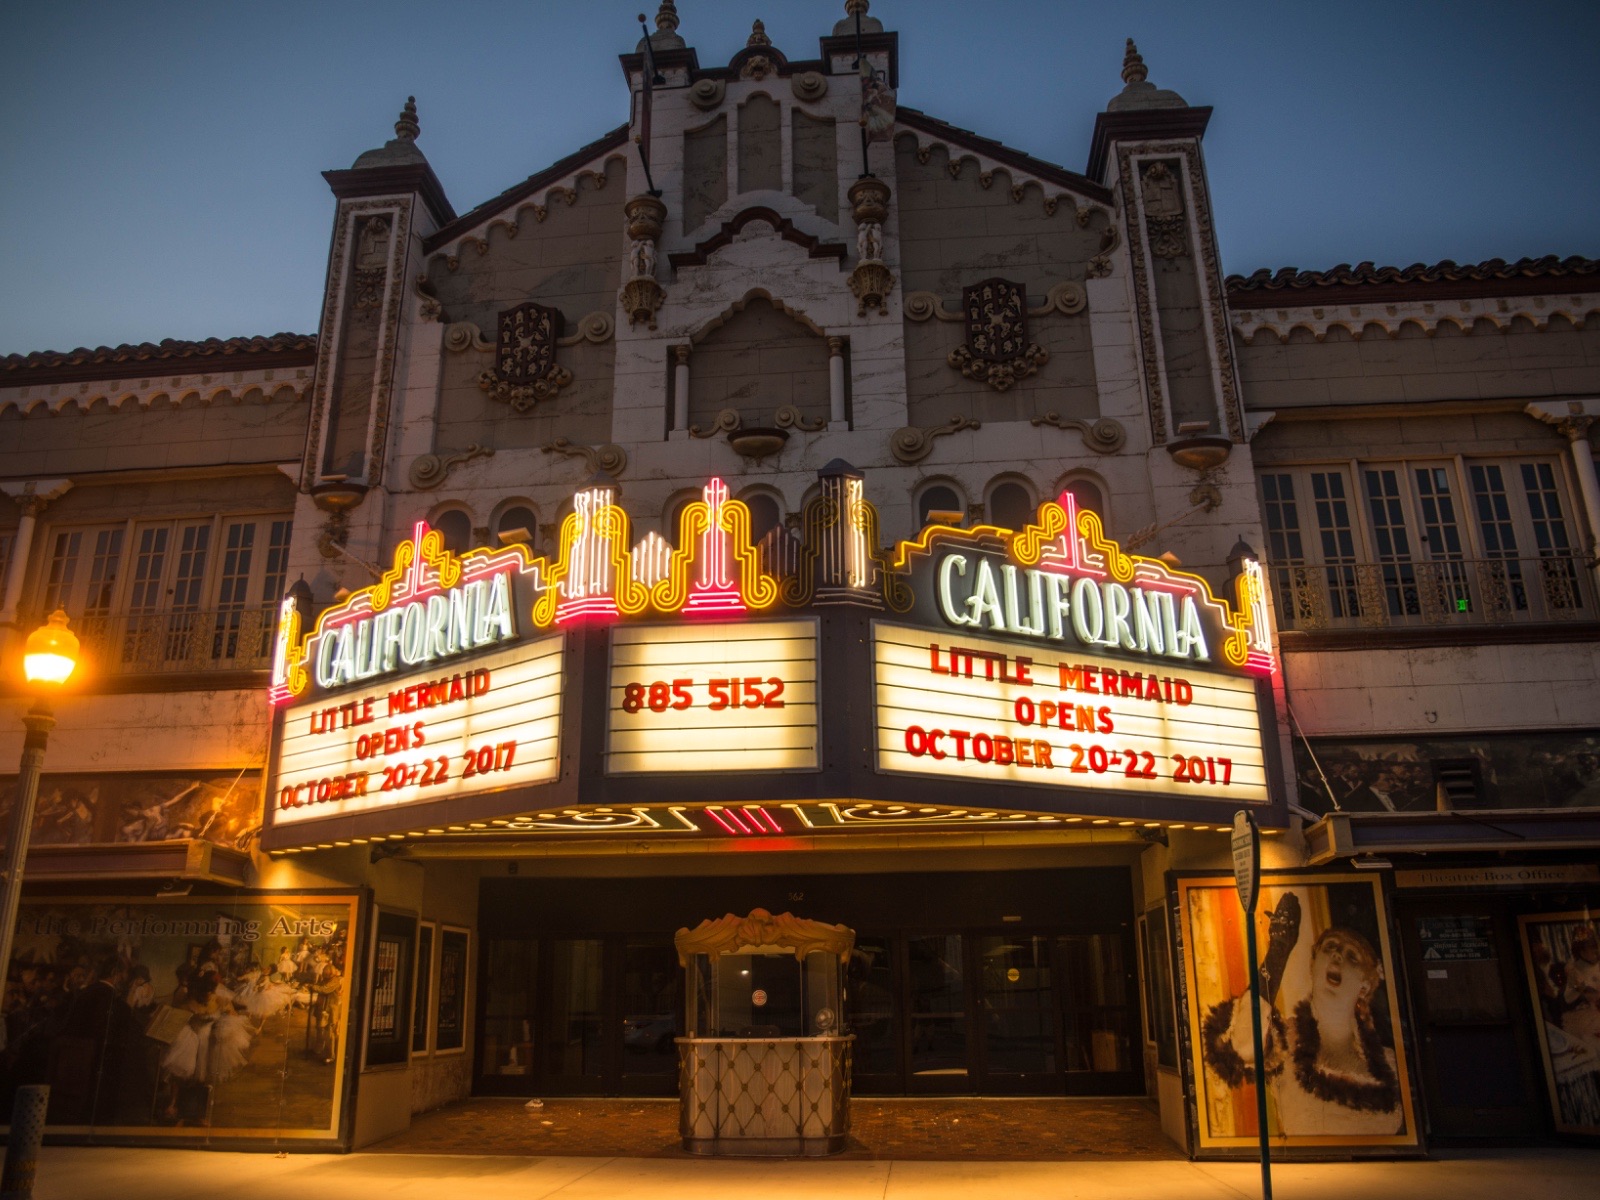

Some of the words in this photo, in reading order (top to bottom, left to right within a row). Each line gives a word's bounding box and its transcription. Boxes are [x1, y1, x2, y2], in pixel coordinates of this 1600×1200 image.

[315, 569, 518, 689] CALIFORNIA
[939, 553, 1211, 661] CALIFORNIA
[309, 696, 376, 735] LITTLE
[387, 667, 491, 718] MERMAID
[622, 679, 693, 714] 885
[707, 676, 785, 711] 5152
[930, 643, 1033, 686] LITTLE
[1058, 661, 1193, 706] MERMAID
[355, 720, 426, 761] OPENS
[1014, 696, 1115, 735] OPENS
[280, 770, 369, 810] OCTOBER
[461, 740, 517, 779] 2017
[904, 725, 1055, 770] OCTOBER
[1070, 743, 1158, 780] 20-22
[1170, 753, 1233, 786] 2017
[1420, 872, 1479, 883] Theatre
[1484, 871, 1514, 882] Box
[1517, 868, 1566, 880] Office
[34, 914, 82, 936] the
[92, 914, 261, 941] Performing
[269, 915, 337, 936] Arts
